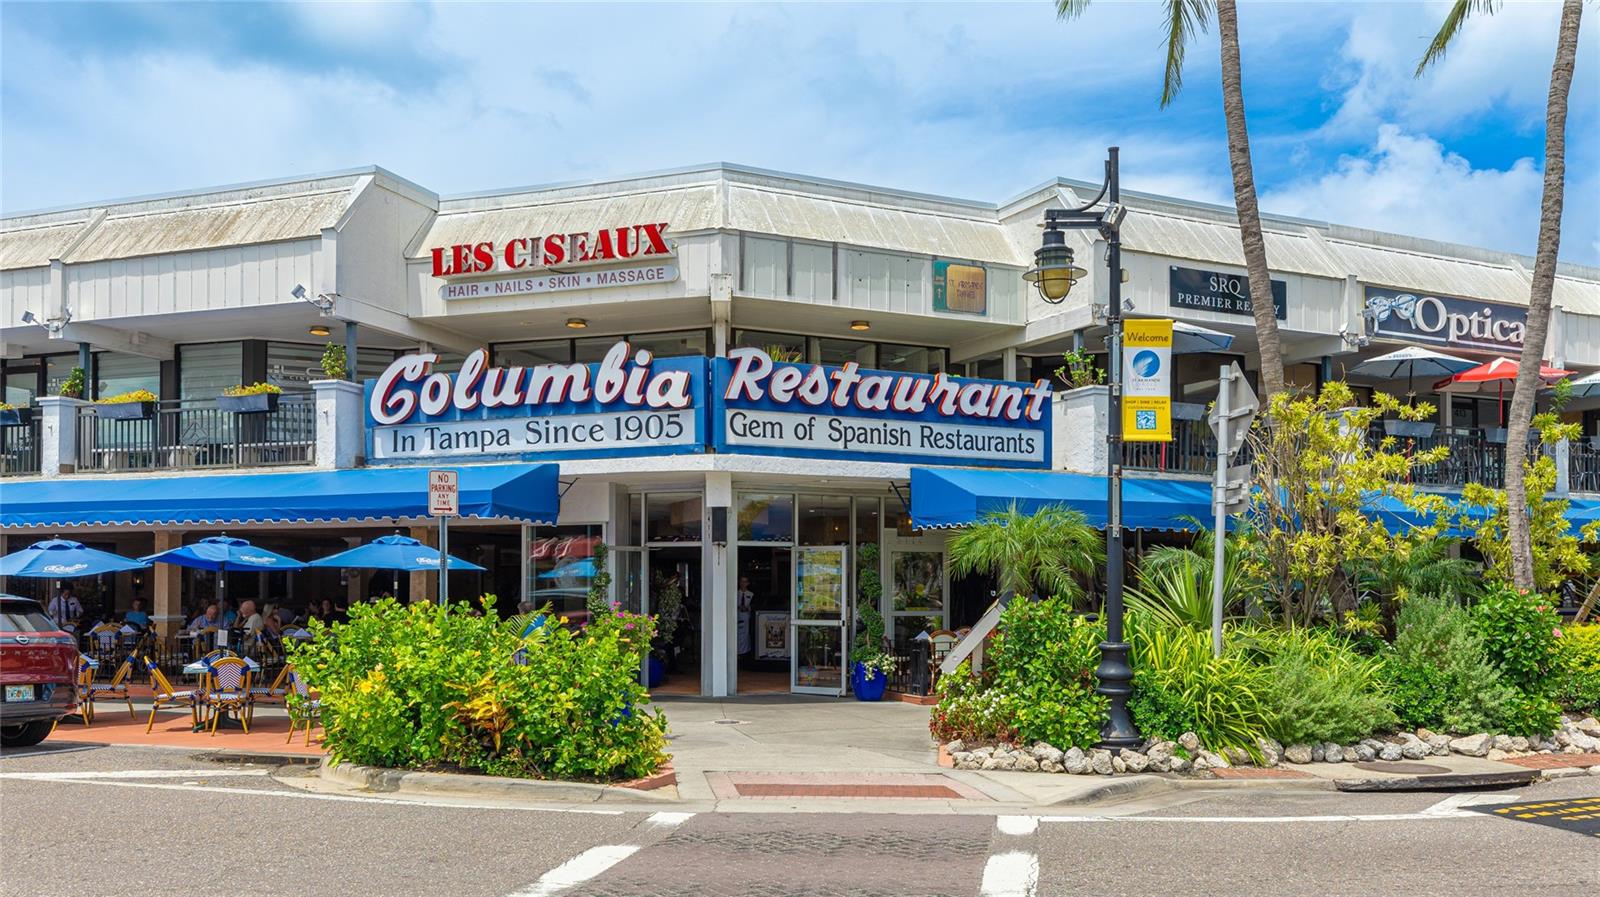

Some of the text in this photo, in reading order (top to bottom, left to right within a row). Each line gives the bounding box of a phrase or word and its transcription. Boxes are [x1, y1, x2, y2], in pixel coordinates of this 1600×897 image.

[430, 222, 671, 277] LES CISEAUX
[448, 267, 665, 297] HAIR NAILS SKIN MASSAGE
[1209, 275, 1246, 299] SRQ
[1177, 292, 1281, 315] PREMIER REY
[1415, 297, 1527, 343] Optica
[1127, 331, 1169, 342] Welcome
[370, 340, 693, 426] Columbia
[724, 347, 1053, 421] Restaurant
[392, 412, 684, 452] In Tampa Since 1905
[729, 412, 1036, 454] Gem of Spanish Restaurants
[431, 484, 456, 493] PARKING
[438, 474, 449, 483] NO
